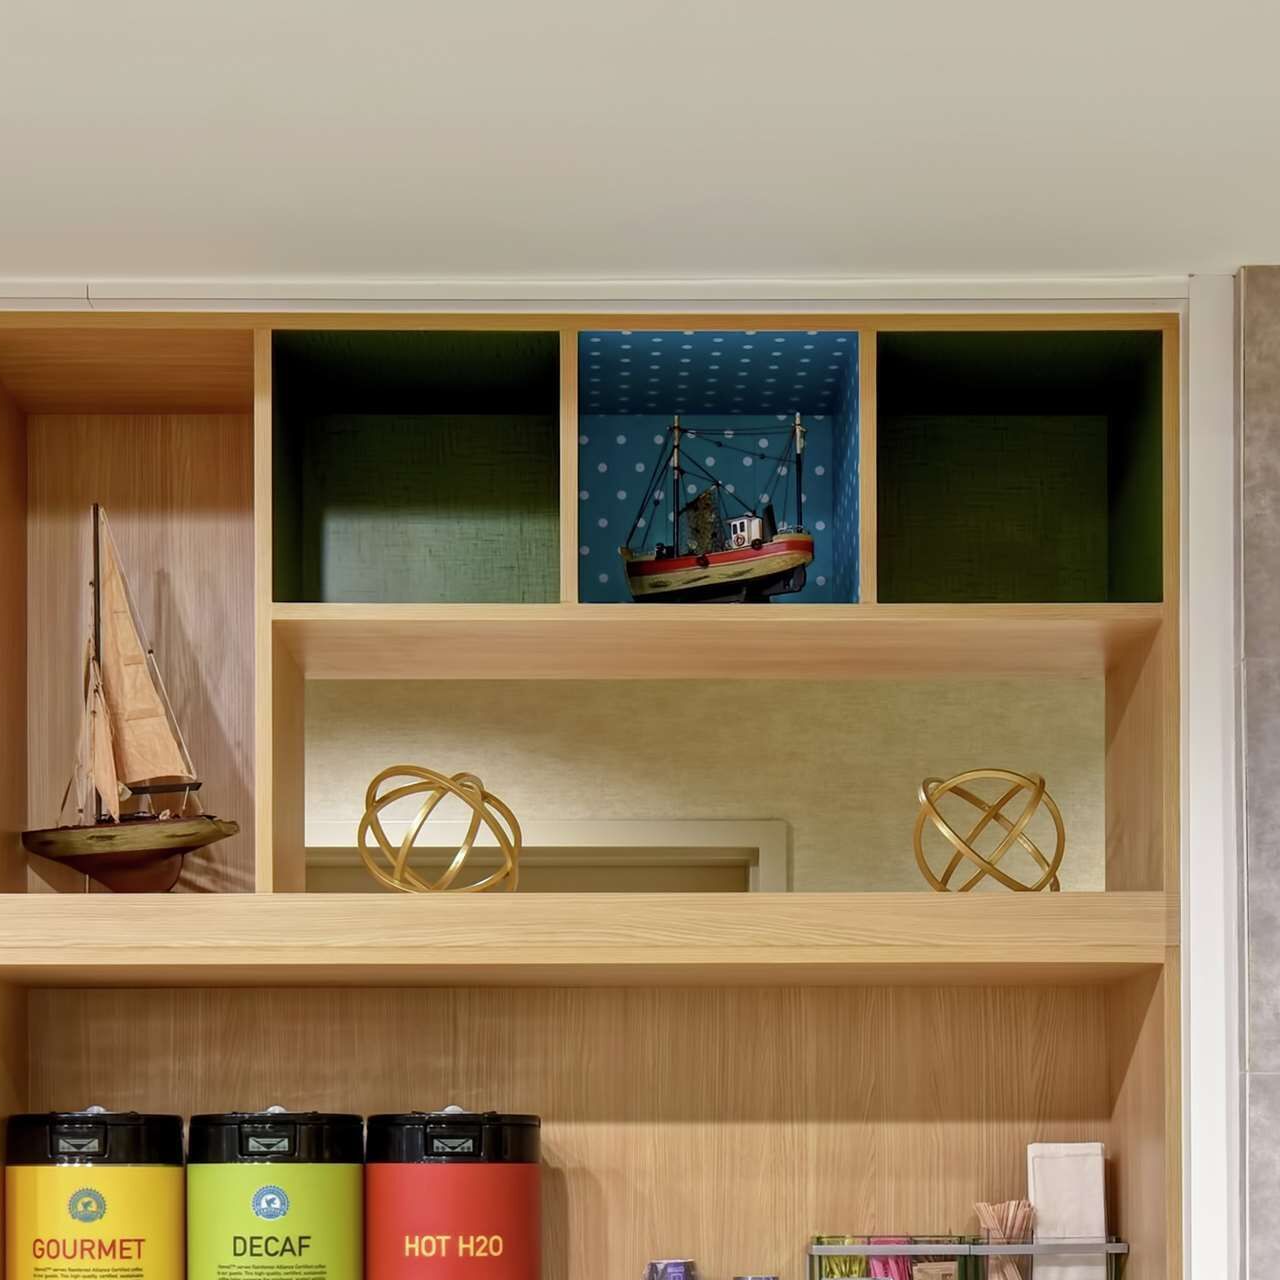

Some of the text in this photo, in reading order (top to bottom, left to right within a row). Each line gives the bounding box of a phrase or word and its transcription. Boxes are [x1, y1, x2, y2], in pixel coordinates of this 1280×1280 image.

[32, 1238, 146, 1260] GOURMET
[232, 1235, 312, 1257] DECAF
[404, 1235, 451, 1257] HOT
